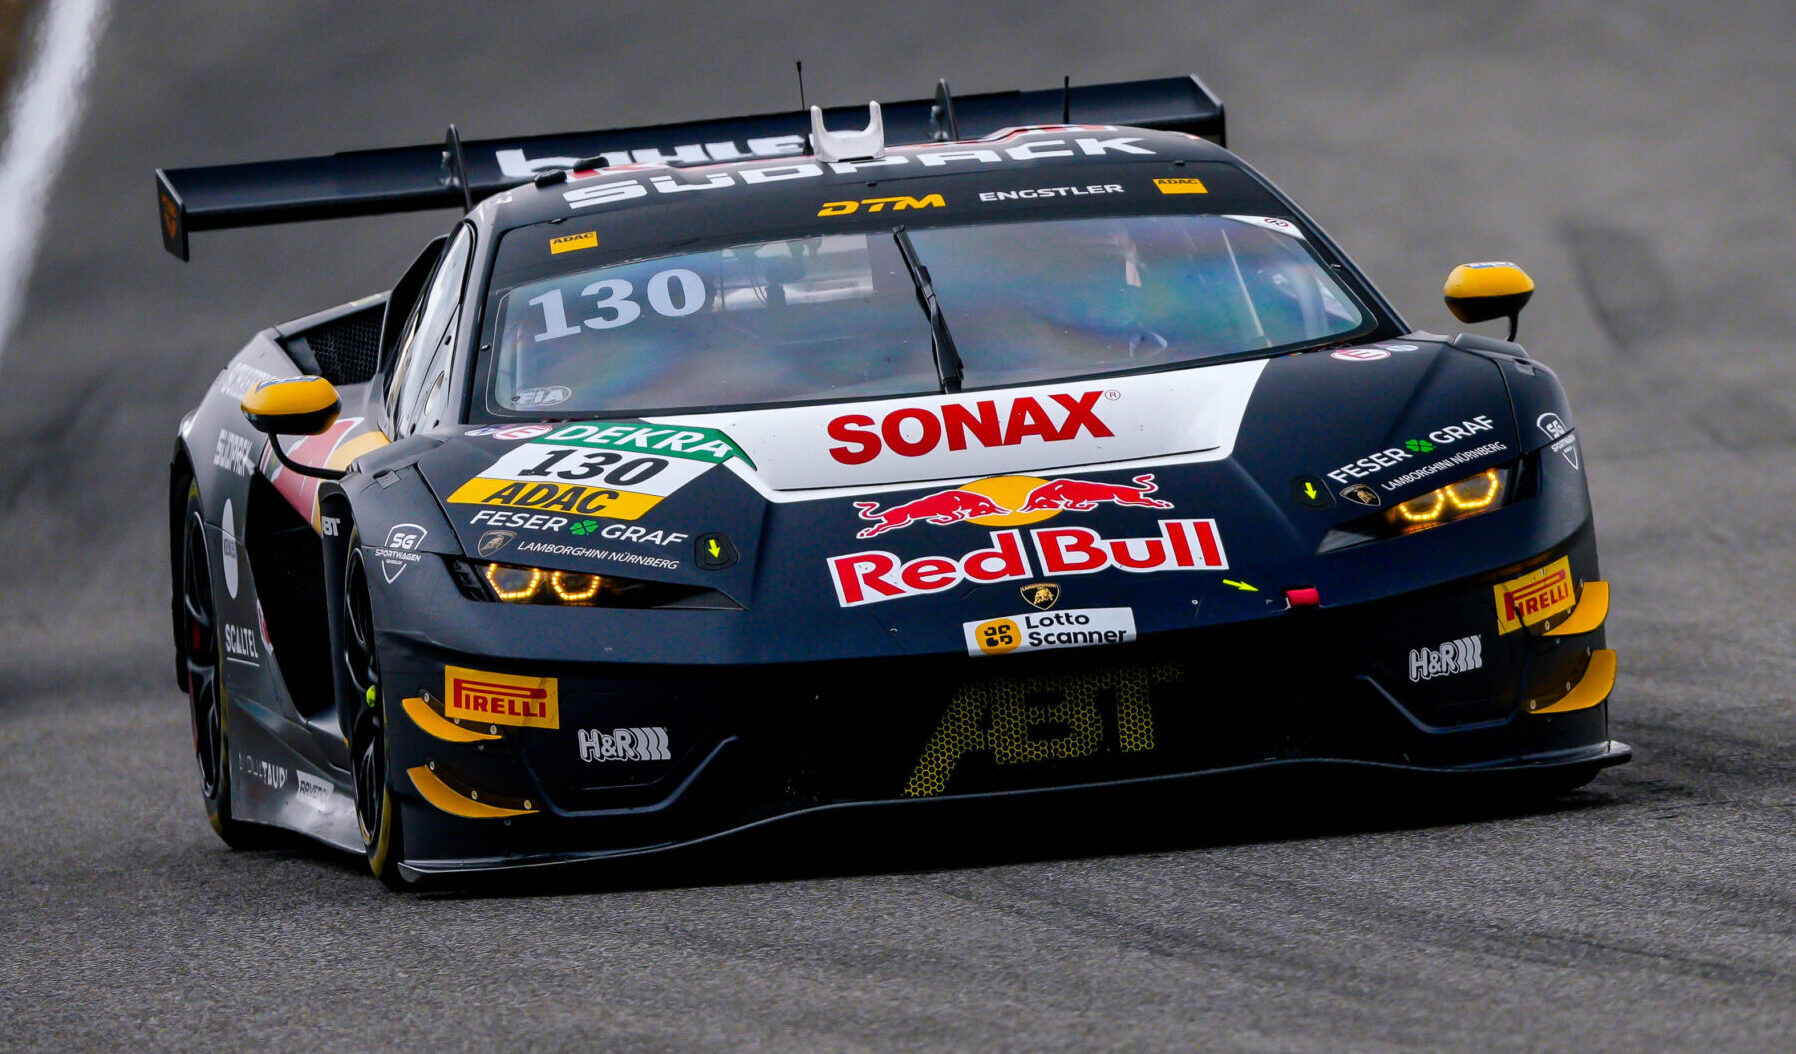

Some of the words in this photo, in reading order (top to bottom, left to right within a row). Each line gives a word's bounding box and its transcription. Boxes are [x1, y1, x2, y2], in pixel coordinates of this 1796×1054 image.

[816, 193, 946, 218] DTM
[979, 183, 1125, 202] ENGSTLER
[552, 232, 594, 244] ADAC
[528, 268, 706, 343] 130
[545, 424, 734, 459] DEKRA
[1326, 447, 1414, 484] FESER
[1428, 414, 1494, 444] GRAF
[517, 449, 670, 486] 130
[1380, 456, 1455, 492] LAMBORGHINI
[1452, 440, 1508, 466] NÜRNBERG
[481, 481, 620, 515] ADAC
[321, 515, 341, 537] BT
[389, 532, 418, 550] SG
[469, 509, 569, 533] FESER
[600, 523, 689, 547] GRAF
[374, 548, 422, 563] SPORTWAGEN
[517, 540, 606, 561] LAMBORGHINI
[606, 549, 680, 571] NÜRNBERG
[826, 528, 1033, 608] Red
[1029, 518, 1229, 577] Bull
[1505, 568, 1568, 622] PIRELLI
[1024, 612, 1090, 630] Lotto
[1027, 626, 1128, 648] Scanner
[1409, 638, 1462, 683] H&R
[453, 678, 548, 718] PIRELLI
[577, 727, 644, 763] H&R
[904, 660, 1185, 797] ABT
